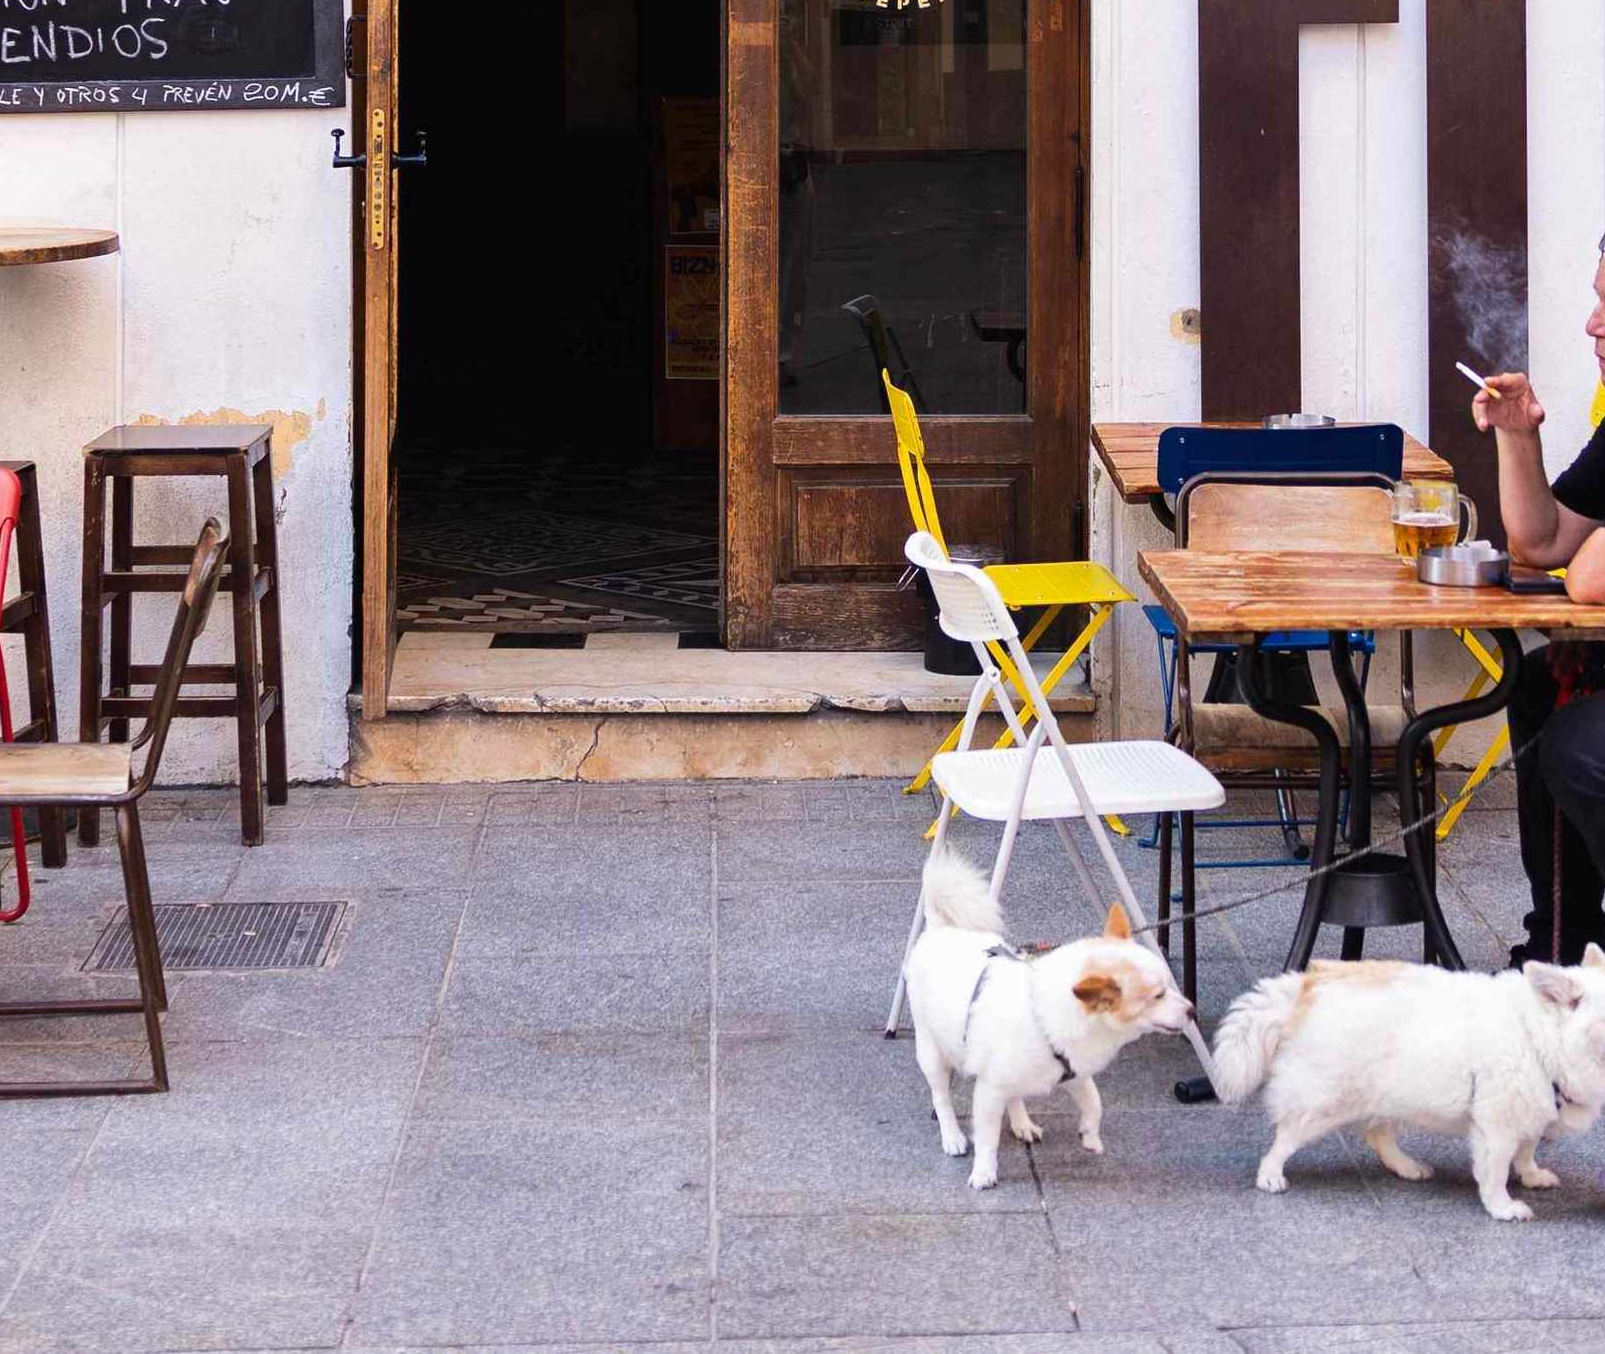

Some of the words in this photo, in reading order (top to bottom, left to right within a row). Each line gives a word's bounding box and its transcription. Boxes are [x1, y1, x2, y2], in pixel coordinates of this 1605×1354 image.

[33, 86, 45, 106] Y
[56, 86, 121, 106] OTROS
[131, 86, 146, 106] 4
[163, 79, 232, 104] PREVÉN
